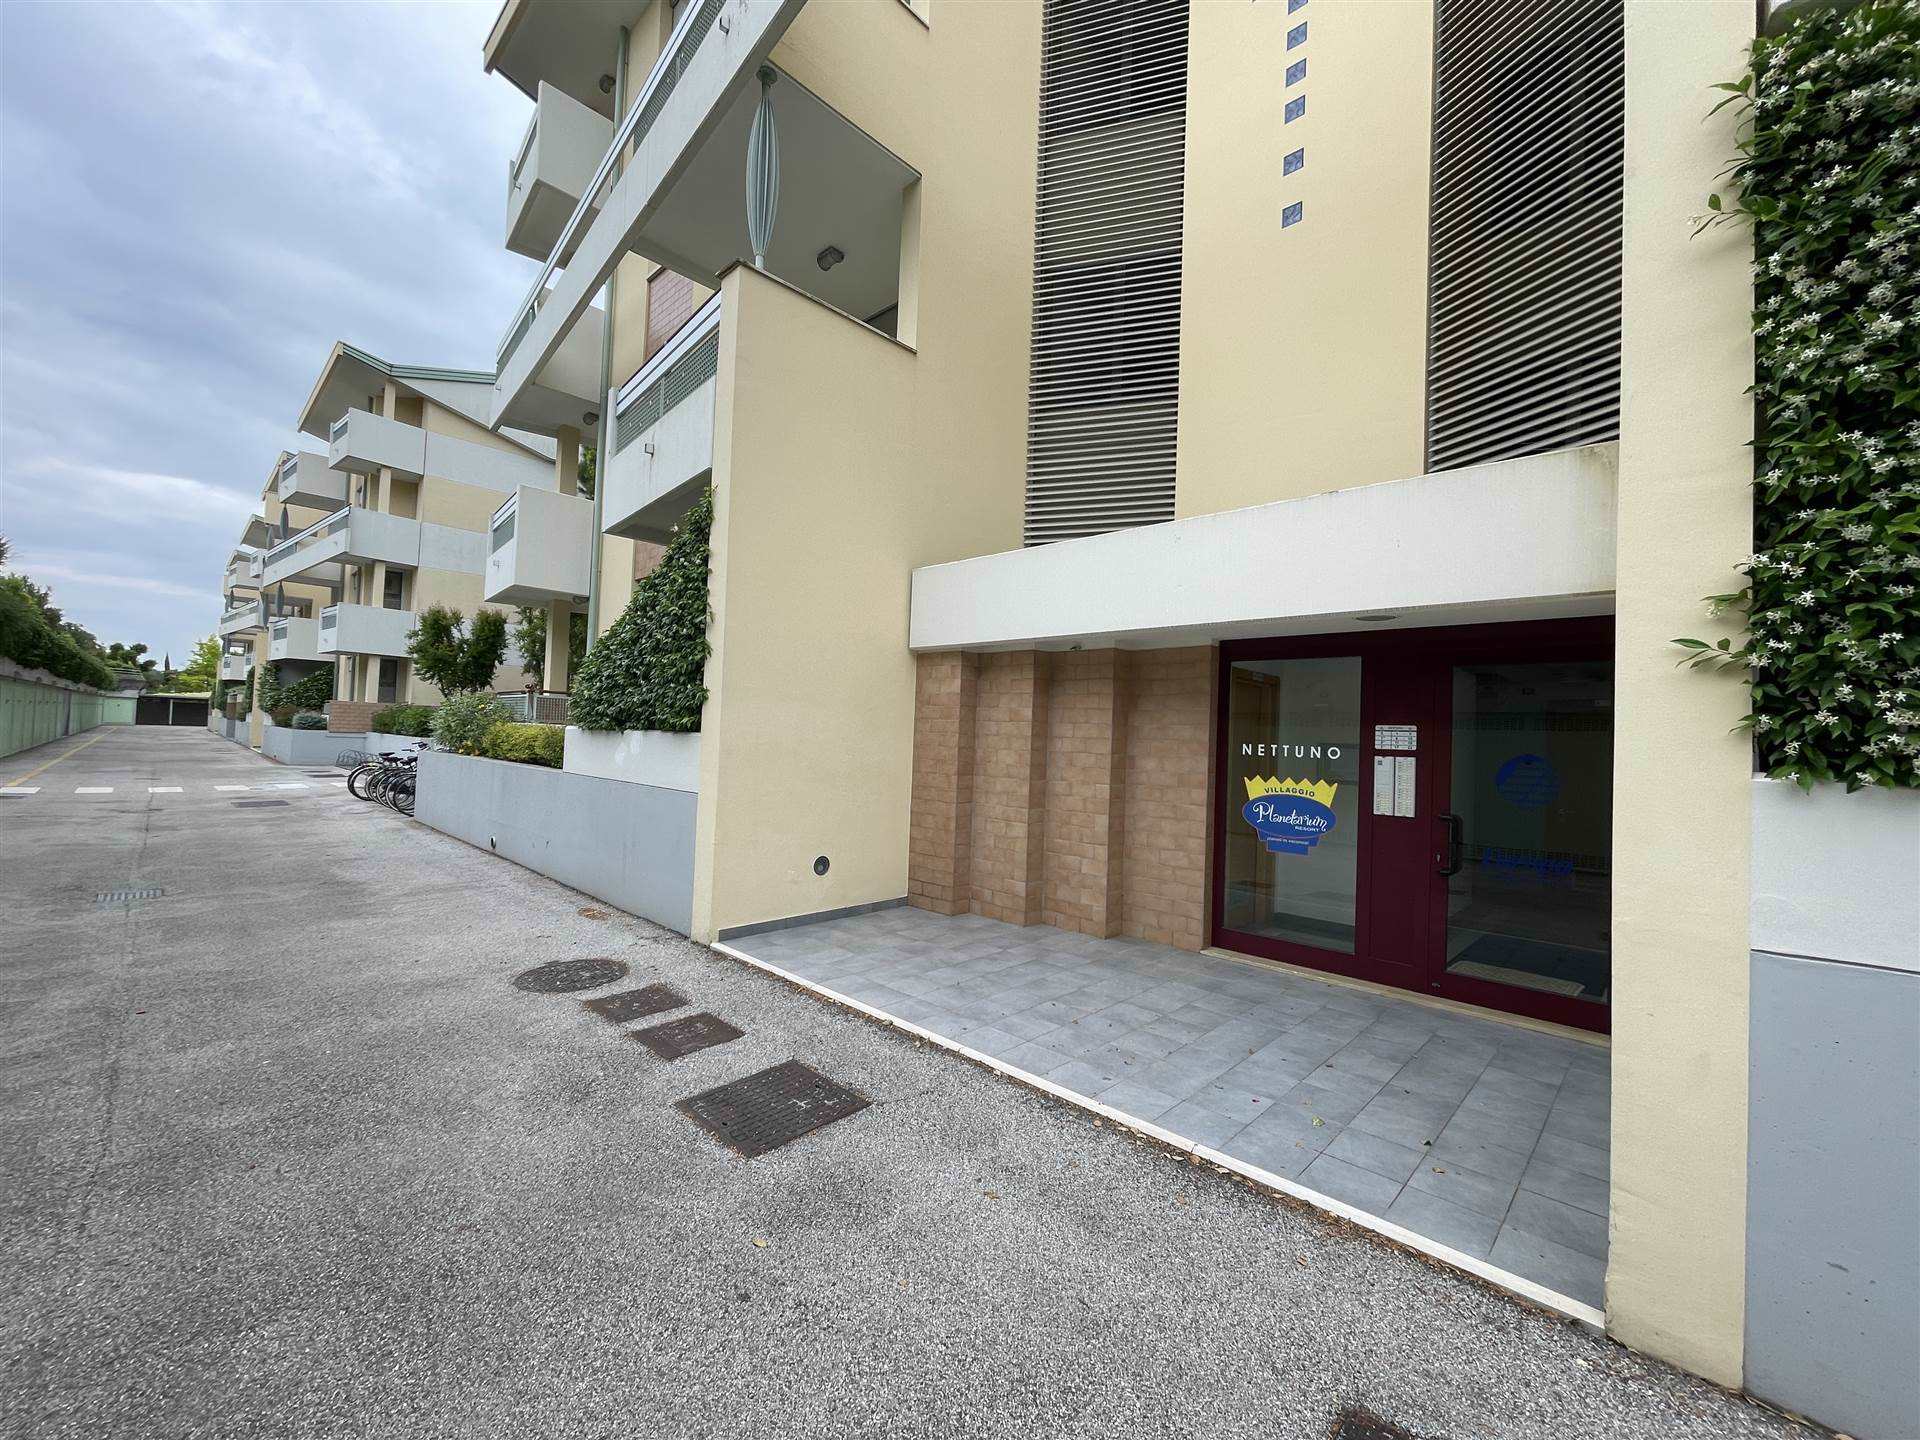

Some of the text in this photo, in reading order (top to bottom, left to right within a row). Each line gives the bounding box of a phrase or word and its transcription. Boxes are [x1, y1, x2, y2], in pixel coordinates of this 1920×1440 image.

[1242, 743, 1341, 760] NETTUNO
[1264, 787, 1315, 797] VILLAGGIO
[1253, 802, 1328, 832] Planetarium
